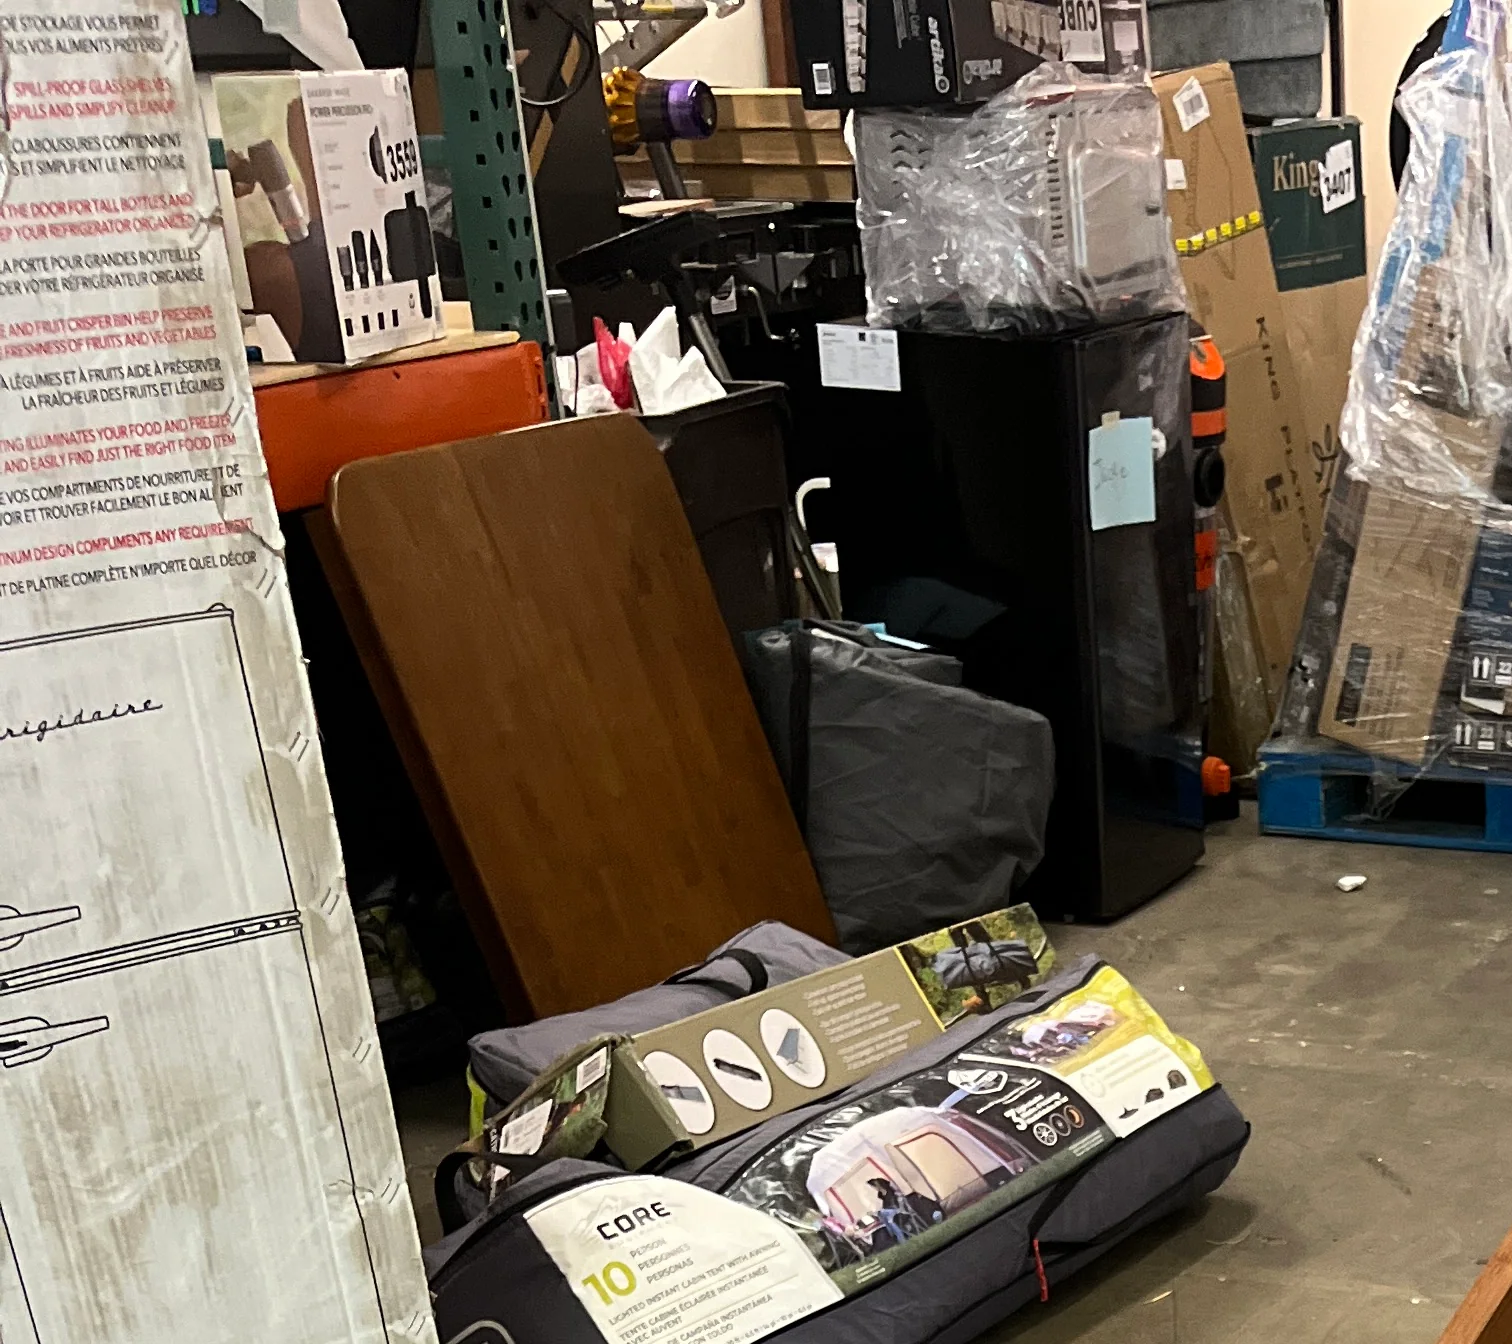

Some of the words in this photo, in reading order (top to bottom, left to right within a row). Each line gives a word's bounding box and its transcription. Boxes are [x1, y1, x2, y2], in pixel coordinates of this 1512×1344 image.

[64, 371, 76, 385] ET
[89, 367, 124, 383] FRUITS
[128, 364, 151, 379] AIDE
[23, 396, 36, 410] LA
[102, 387, 122, 402] DES
[124, 384, 159, 400] FRUITS
[98, 425, 128, 441] YOUR
[130, 421, 162, 437] FOOD
[164, 418, 188, 433] AND
[4, 458, 29, 473] AND
[69, 450, 94, 465] FIND
[97, 447, 120, 462] JUST
[123, 444, 144, 459] THE
[146, 440, 176, 456] RIGHT
[179, 436, 211, 452] FOOD
[7, 488, 31, 504] VOS
[32, 477, 125, 502] COMPARTIMENTS
[127, 475, 140, 490] DE
[143, 467, 211, 488] NOURRITURE
[227, 463, 240, 479] DE
[39, 502, 89, 522] TROUVER
[91, 493, 156, 515] FACILEMENT
[172, 488, 197, 505] BON
[155, 529, 176, 546] ANY
[10, 580, 24, 595] DE
[27, 574, 70, 593] PLATINE
[189, 555, 218, 572] QUEL
[597, 1202, 671, 1241] CORE
[581, 1260, 638, 1306] 10
[646, 1258, 694, 1284] PERSONAS
